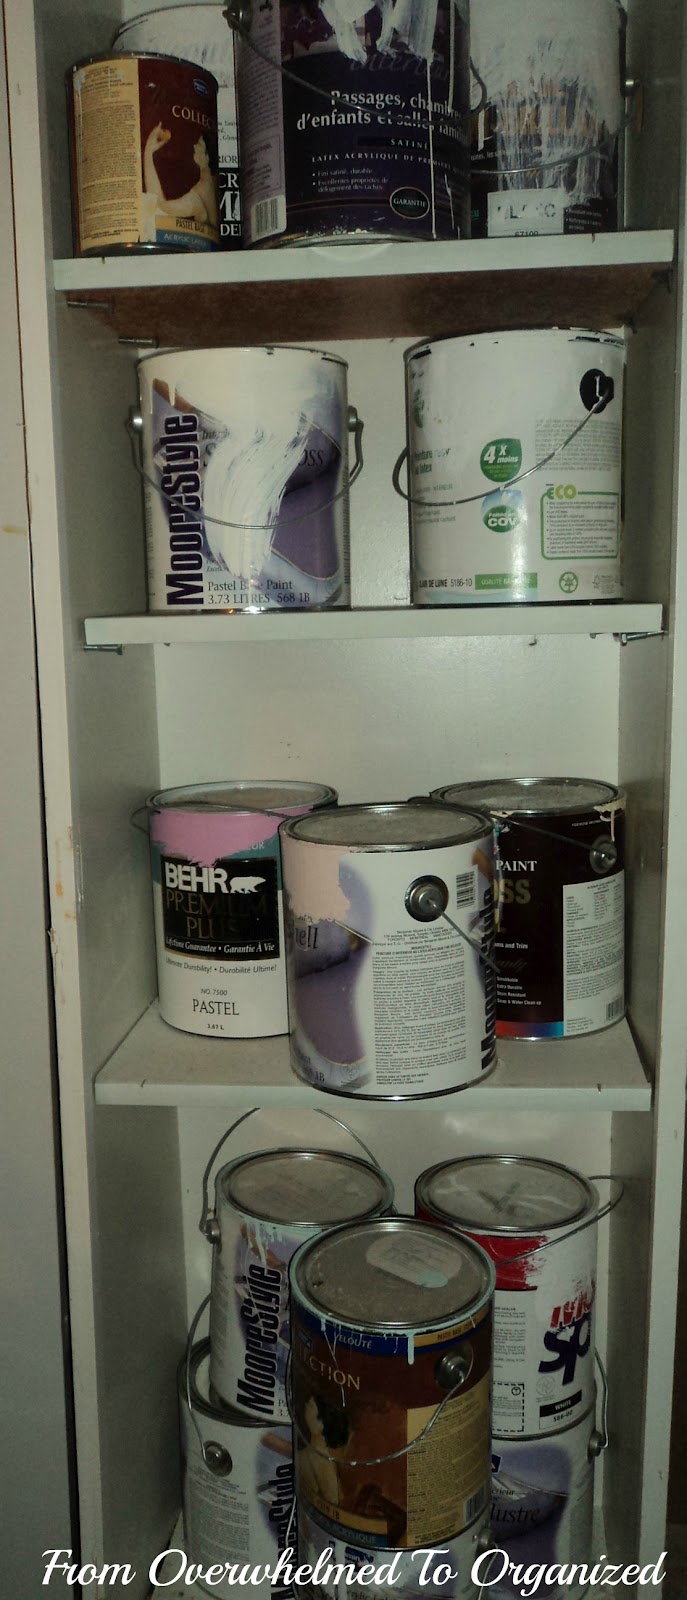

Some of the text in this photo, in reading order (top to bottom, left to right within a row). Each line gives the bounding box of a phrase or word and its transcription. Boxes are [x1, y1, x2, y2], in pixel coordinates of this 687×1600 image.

[331, 90, 406, 109] Passages,
[296, 108, 371, 131] d'enfants
[344, 152, 399, 161] ACRYLIQUE
[484, 446, 496, 464] 4
[207, 579, 294, 592] Pastel Be Paint
[207, 593, 231, 605] 3.73
[276, 592, 297, 603] 568
[495, 860, 538, 872] PAINT
[164, 861, 229, 895] BEHR
[165, 889, 270, 918] PREMIUM
[185, 916, 241, 940] PLUS
[223, 944, 255, 954] Garantie
[253, 964, 277, 973] Ultime!
[212, 988, 228, 996] 7500
[192, 998, 240, 1016] PASTEL
[555, 1400, 572, 1410] WHITE
